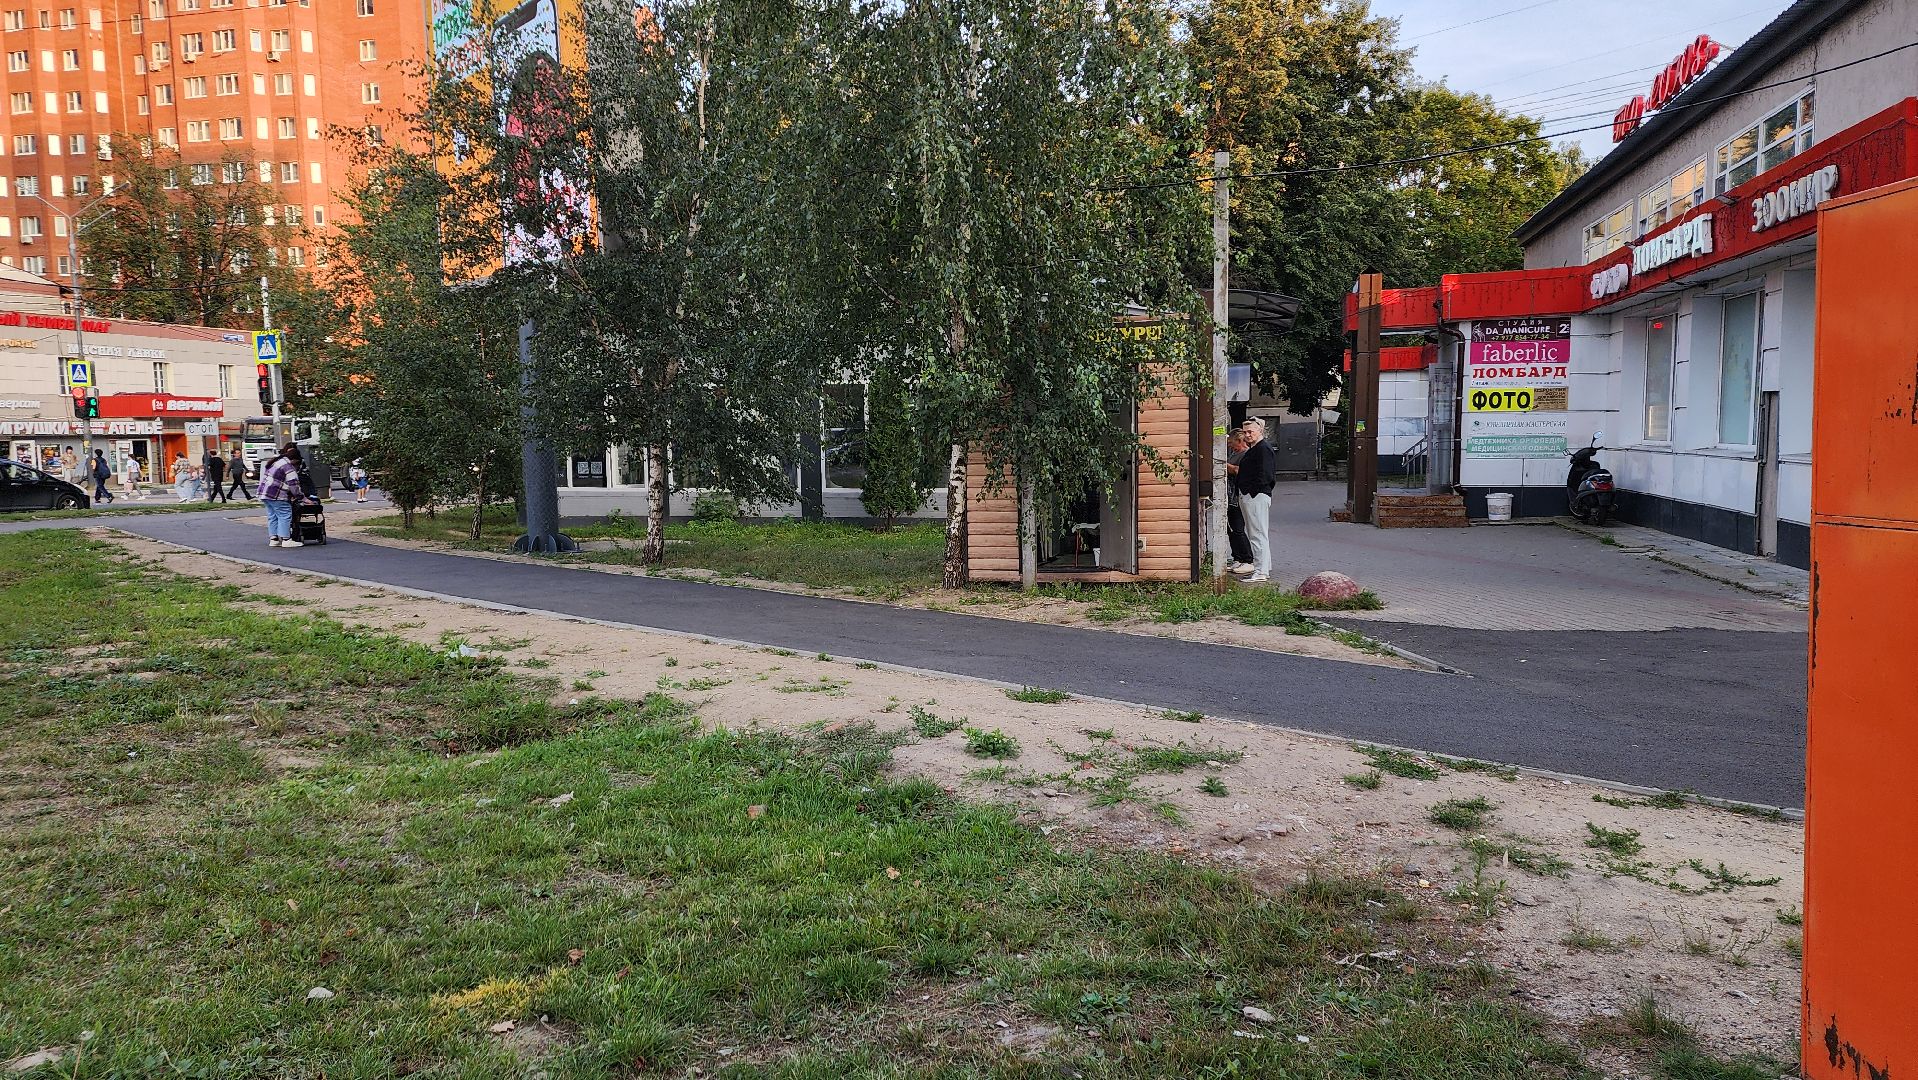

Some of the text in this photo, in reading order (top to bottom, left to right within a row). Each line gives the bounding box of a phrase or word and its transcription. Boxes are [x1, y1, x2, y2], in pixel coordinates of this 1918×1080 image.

[1752, 165, 1839, 232] ЗООМИР
[1632, 213, 1713, 276] ЛОМБАРД
[26, 315, 112, 333] УНИВЕМАГ
[1498, 319, 1543, 327] СТУДИЯ
[1482, 341, 1558, 362] faberlic
[1472, 366, 1567, 379] ЛОМБАРД
[1472, 391, 1531, 410] ФОТО
[0, 422, 69, 434] ИГРУШКИ
[108, 421, 162, 434] АТЕЛЬЕ
[188, 425, 214, 434] СТОП
[1470, 437, 1565, 446] МЕДТЕХНИКА ОРТОПЕДИЯ
